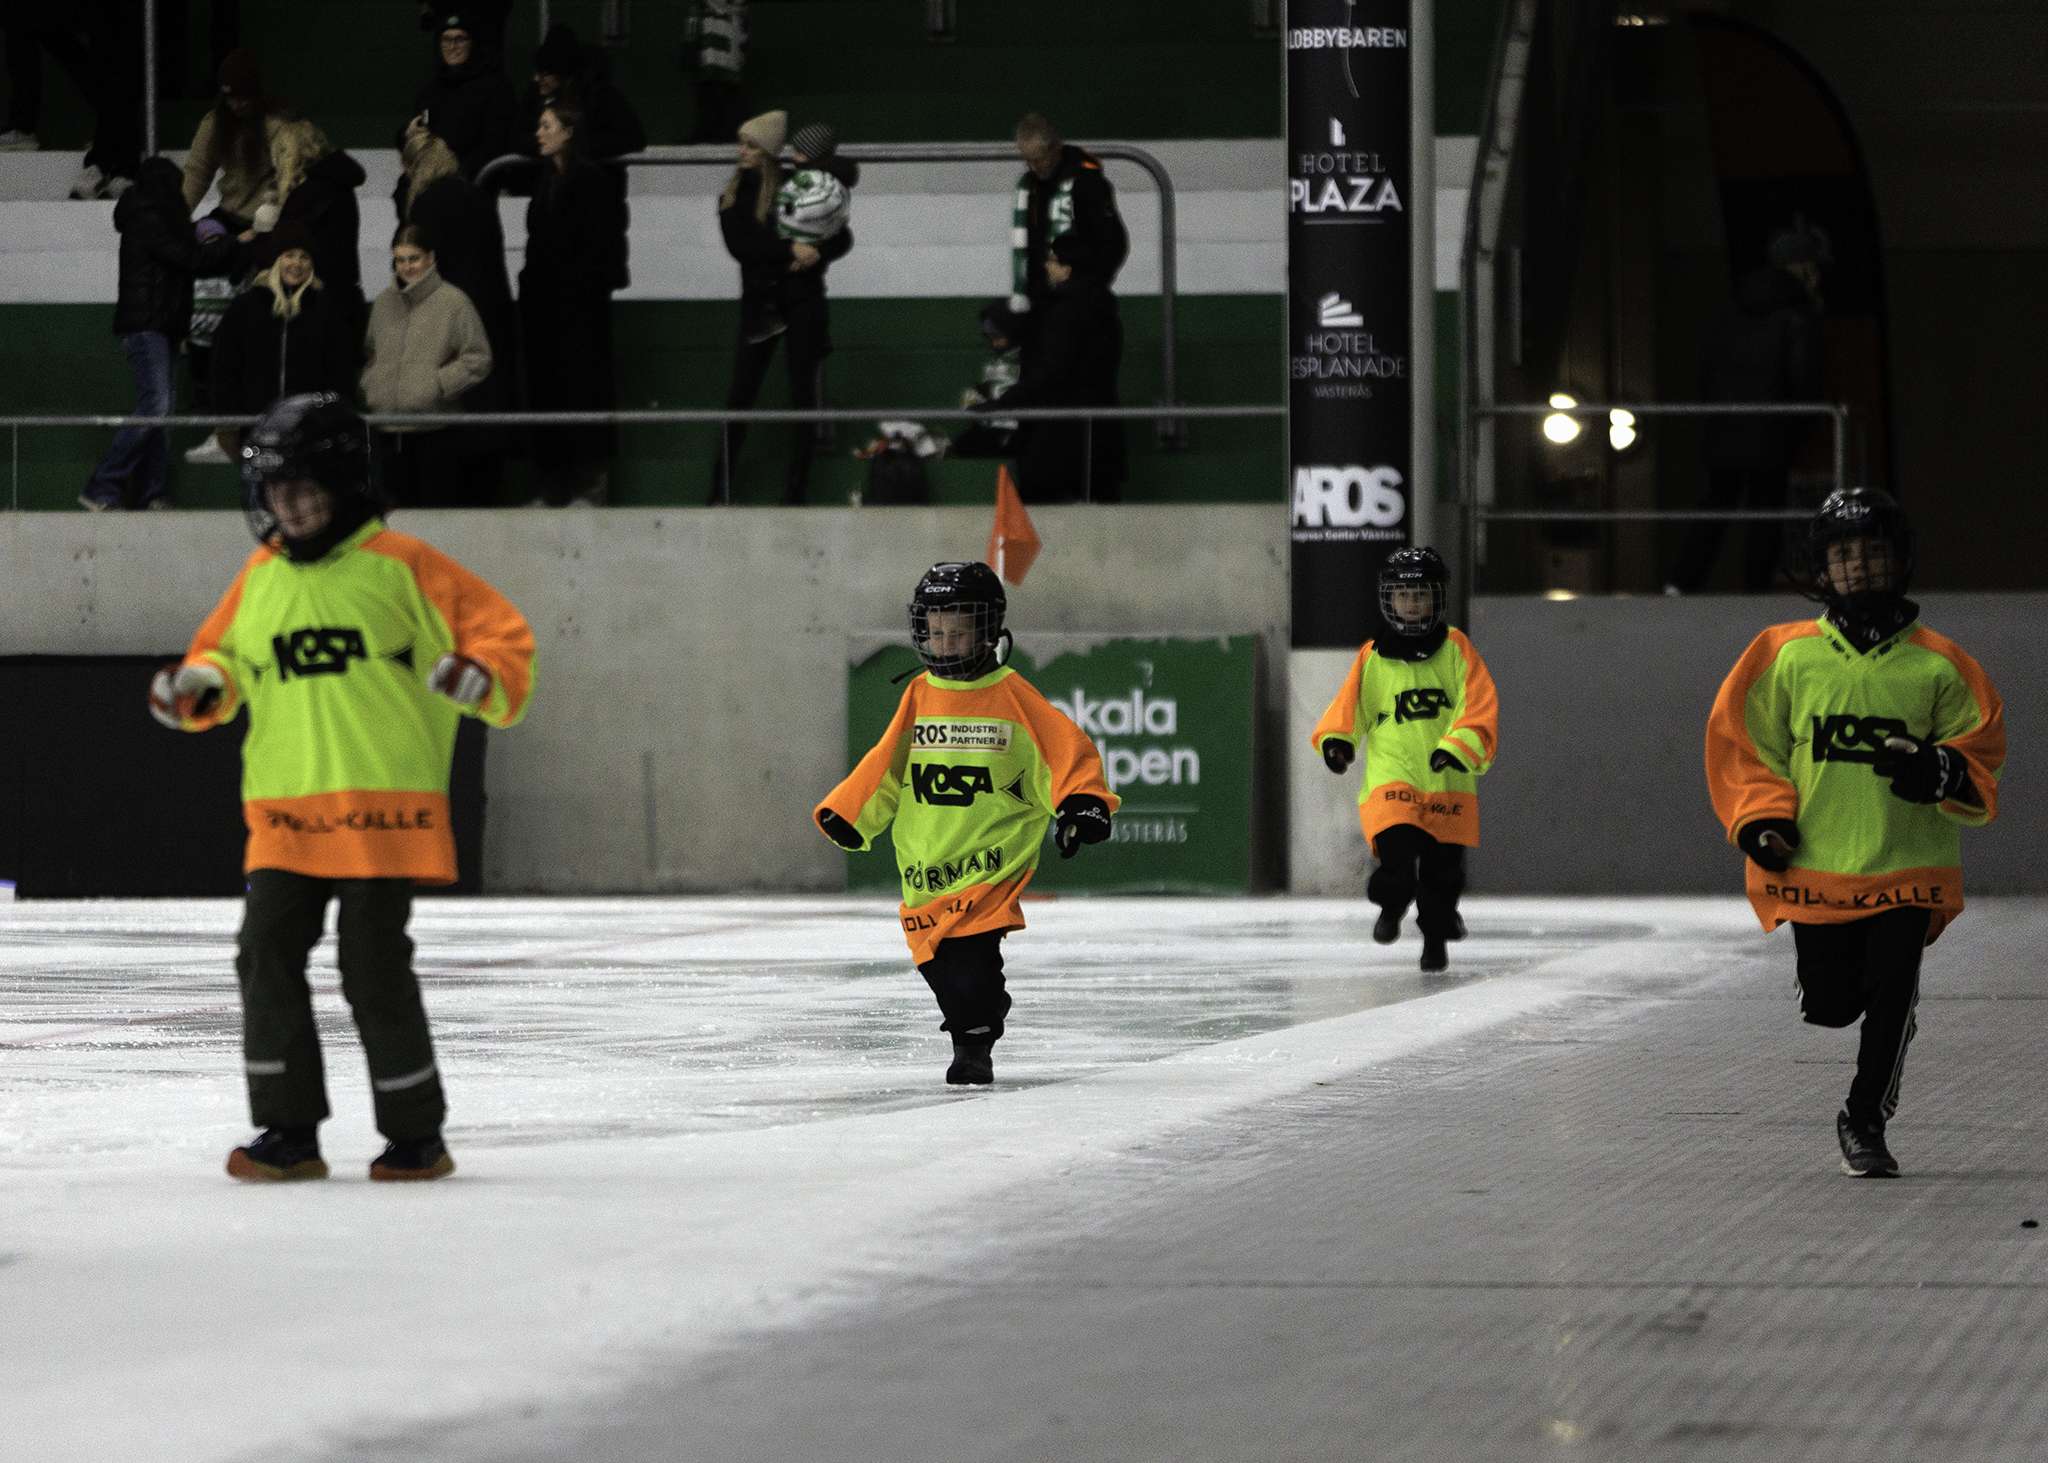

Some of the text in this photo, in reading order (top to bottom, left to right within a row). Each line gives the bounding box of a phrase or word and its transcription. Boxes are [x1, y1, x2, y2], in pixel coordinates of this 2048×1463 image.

[1289, 28, 1408, 49] LOBBYBAREN
[1302, 153, 1386, 174] HOTEL
[1290, 177, 1403, 213] PLAZA
[1307, 332, 1379, 354] HOTEL
[1291, 356, 1406, 379] ESPLANADE
[1292, 465, 1405, 528] AROS
[272, 626, 367, 683] KOSA
[1050, 688, 1178, 735] kala
[1394, 688, 1453, 724] KOSA
[912, 724, 947, 746] ROS
[950, 736, 996, 745] PARTNER
[911, 762, 994, 807] KOSA
[1110, 817, 1188, 842] ÄSTERÅS
